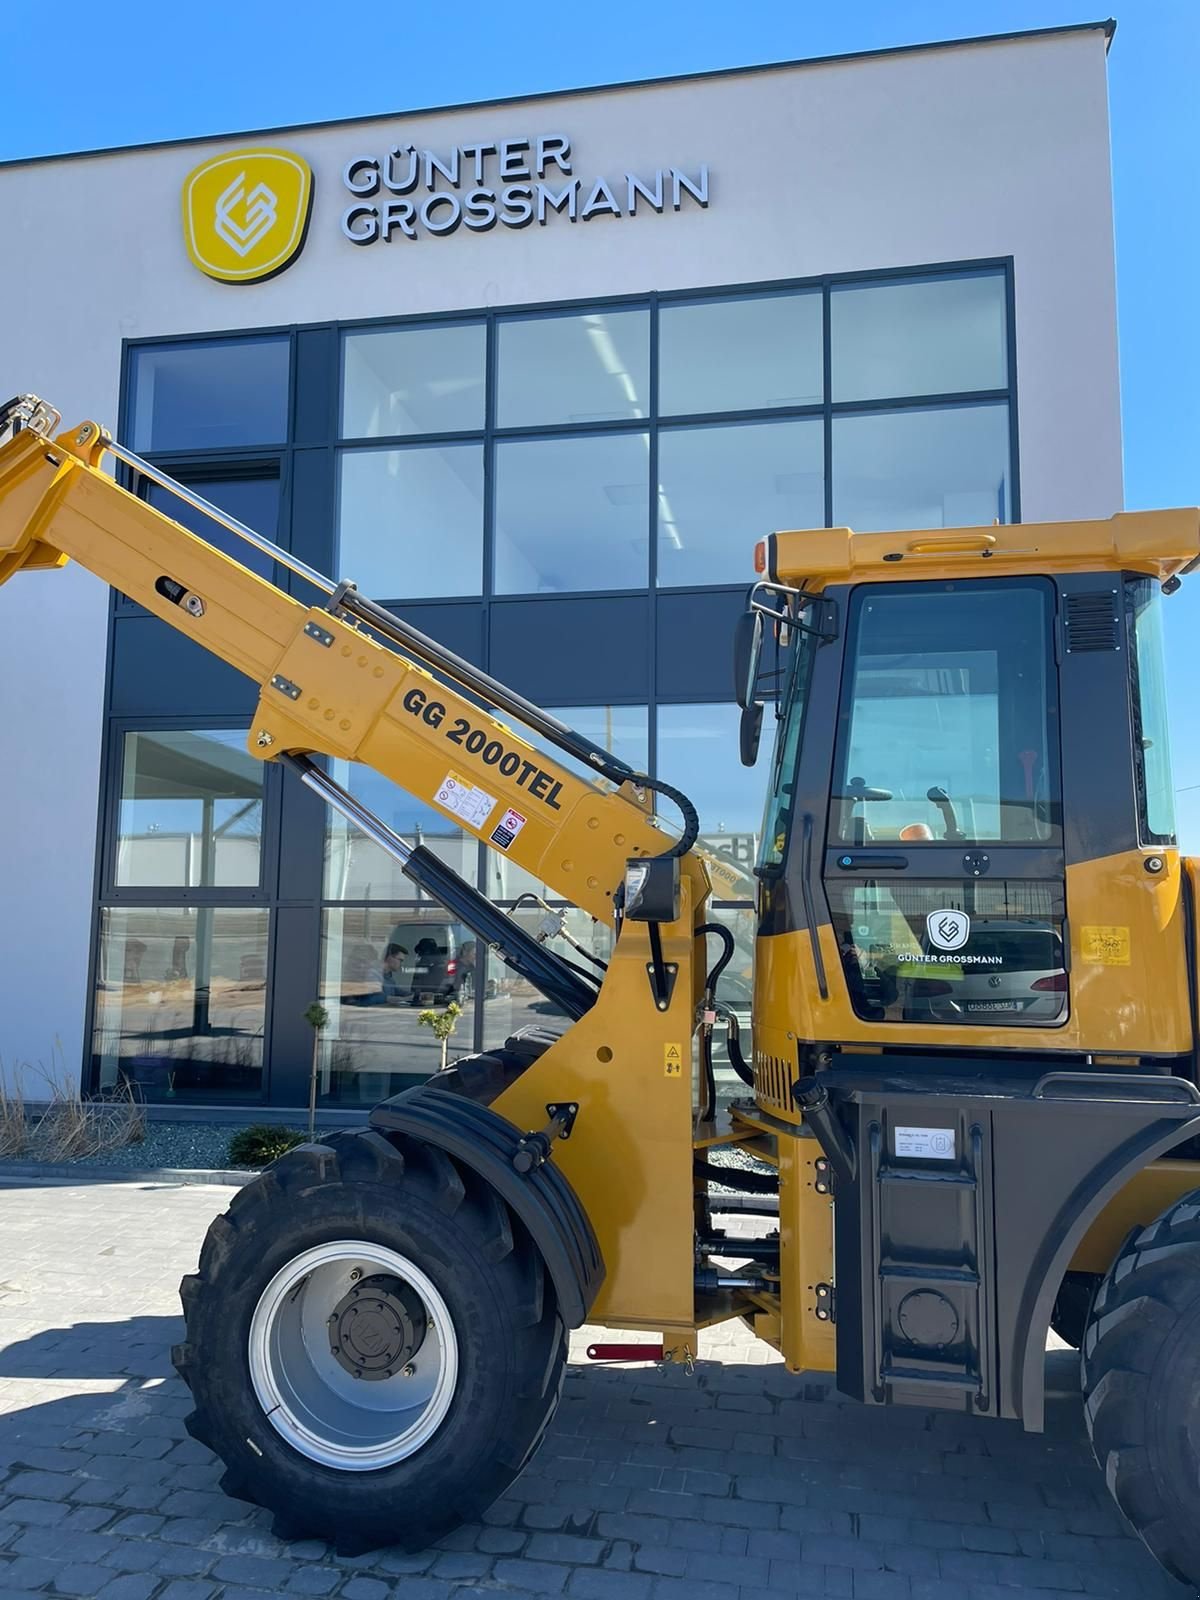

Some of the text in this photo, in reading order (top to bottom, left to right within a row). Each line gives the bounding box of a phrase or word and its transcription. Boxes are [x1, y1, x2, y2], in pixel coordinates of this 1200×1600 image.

[342, 133, 571, 197] GÜNTER
[341, 165, 709, 246] GROSSMANN
[403, 689, 446, 729] GG
[445, 718, 564, 811] 2000TEL
[897, 952, 1003, 965] GÜNTER GROSSMANN
